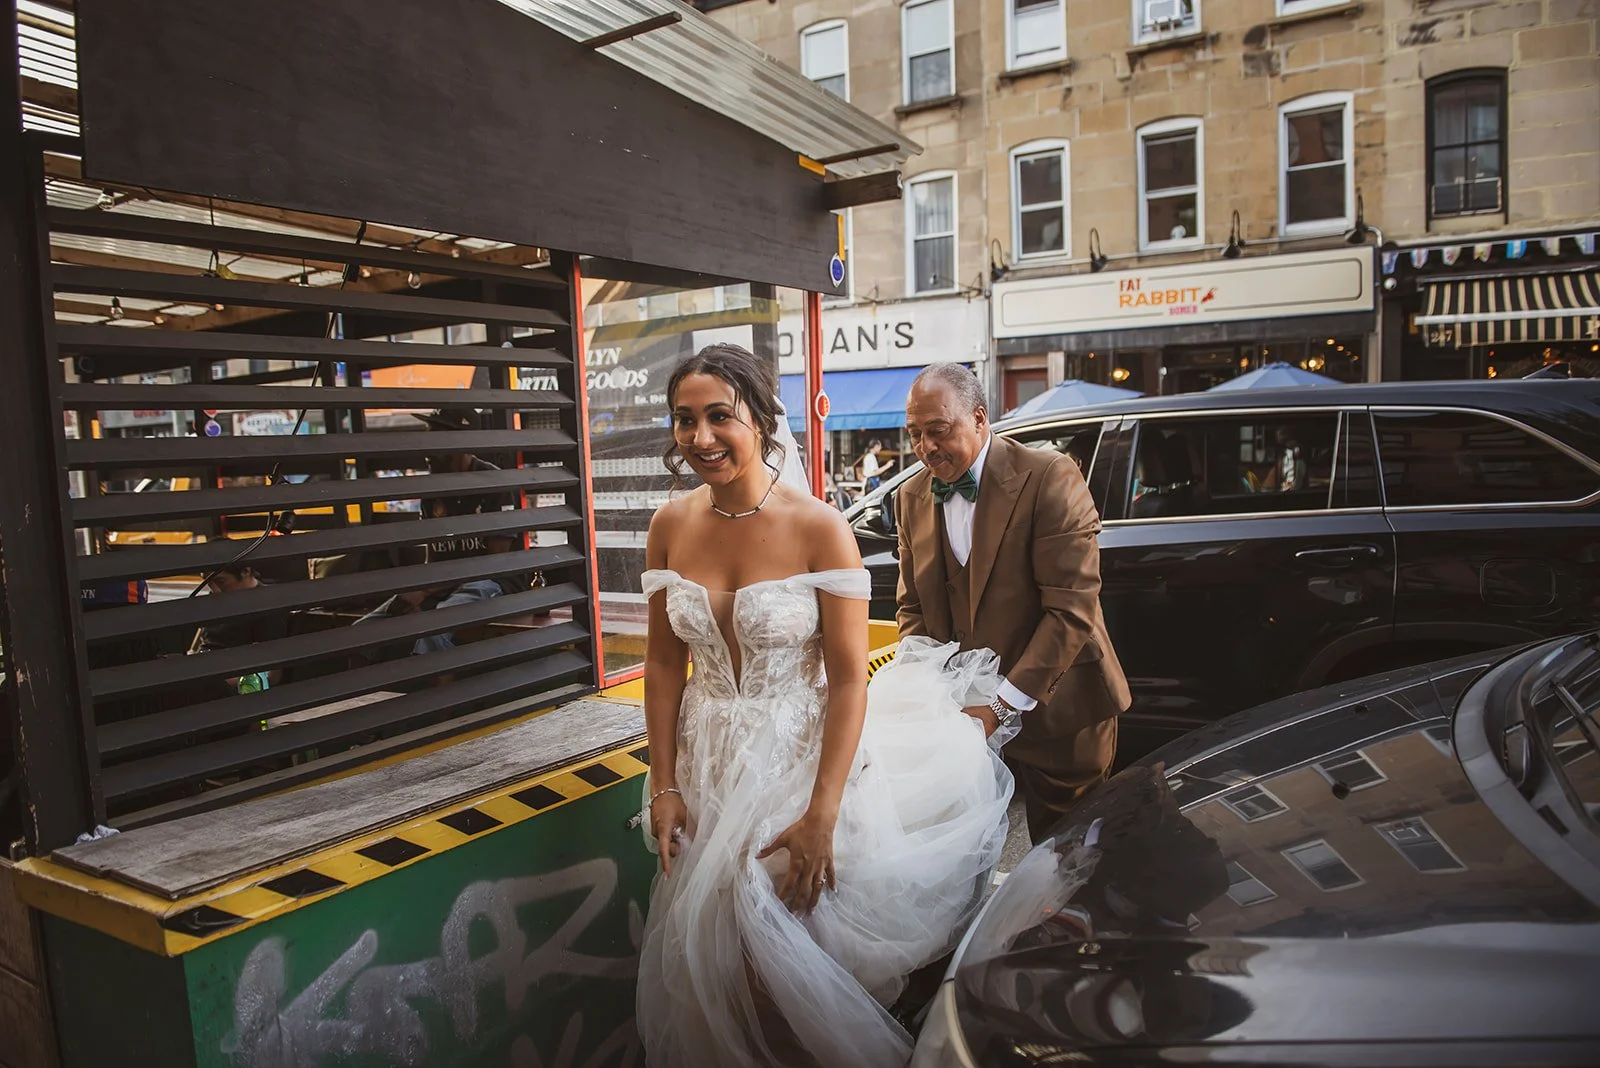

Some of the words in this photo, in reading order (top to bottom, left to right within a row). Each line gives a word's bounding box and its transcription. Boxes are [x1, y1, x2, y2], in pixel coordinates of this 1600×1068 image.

[1119, 278, 1141, 291] FAT
[1119, 287, 1201, 309] RABBIT
[1430, 329, 1453, 347] 247
